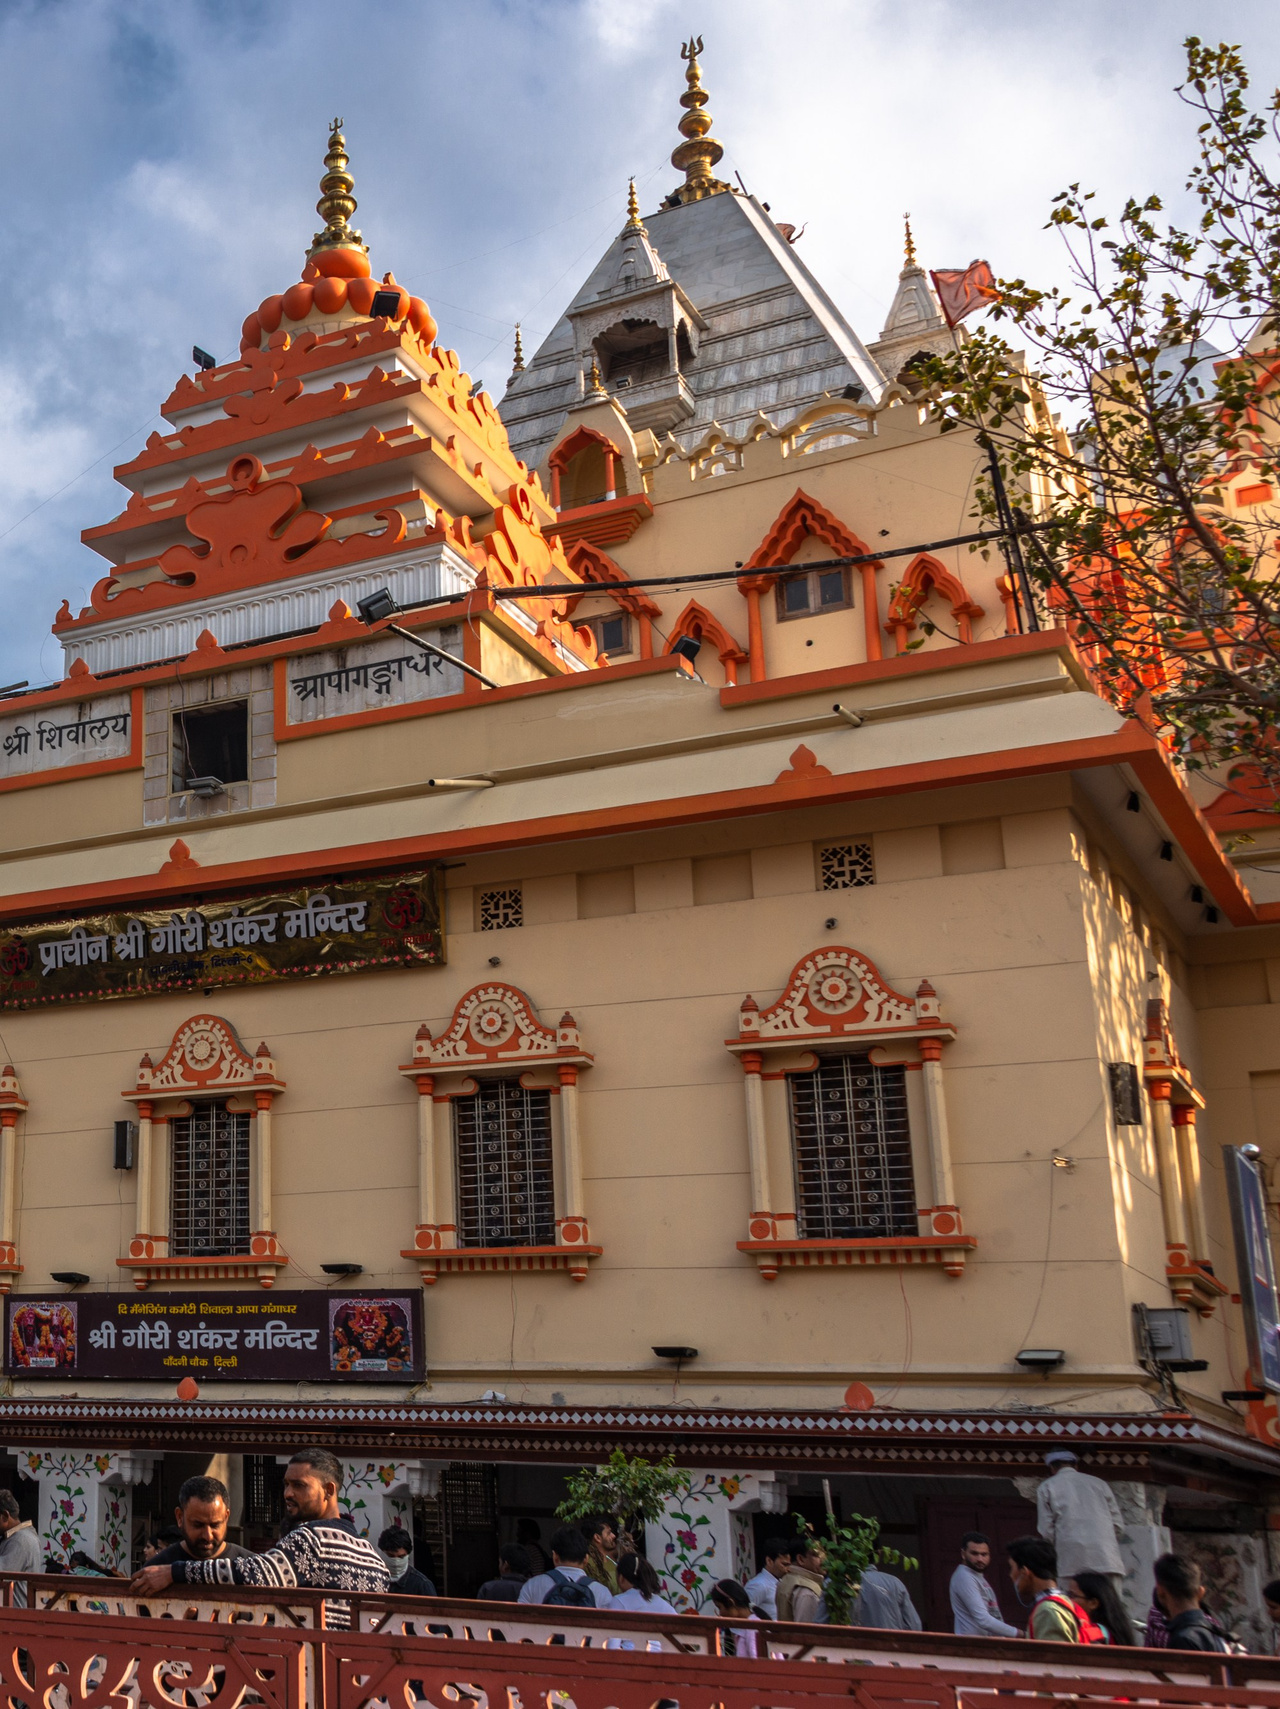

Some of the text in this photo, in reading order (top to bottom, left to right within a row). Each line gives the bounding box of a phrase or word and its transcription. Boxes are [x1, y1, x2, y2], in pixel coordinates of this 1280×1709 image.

[3, 713, 131, 757] श्री शिवालय
[38, 894, 368, 977] प्राचीन श्री गौरी शंकर मन्दिर
[117, 1303, 128, 1315] दि
[169, 1303, 196, 1315] कमेटी
[200, 1303, 233, 1315] शिवाला
[236, 1305, 259, 1315] आपा
[261, 1302, 297, 1315] गंगाधर
[88, 1320, 320, 1351] श्री गौरी शंकर मन्दिर
[189, 1356, 209, 1367] चौक
[214, 1355, 238, 1368] दिल्ली
